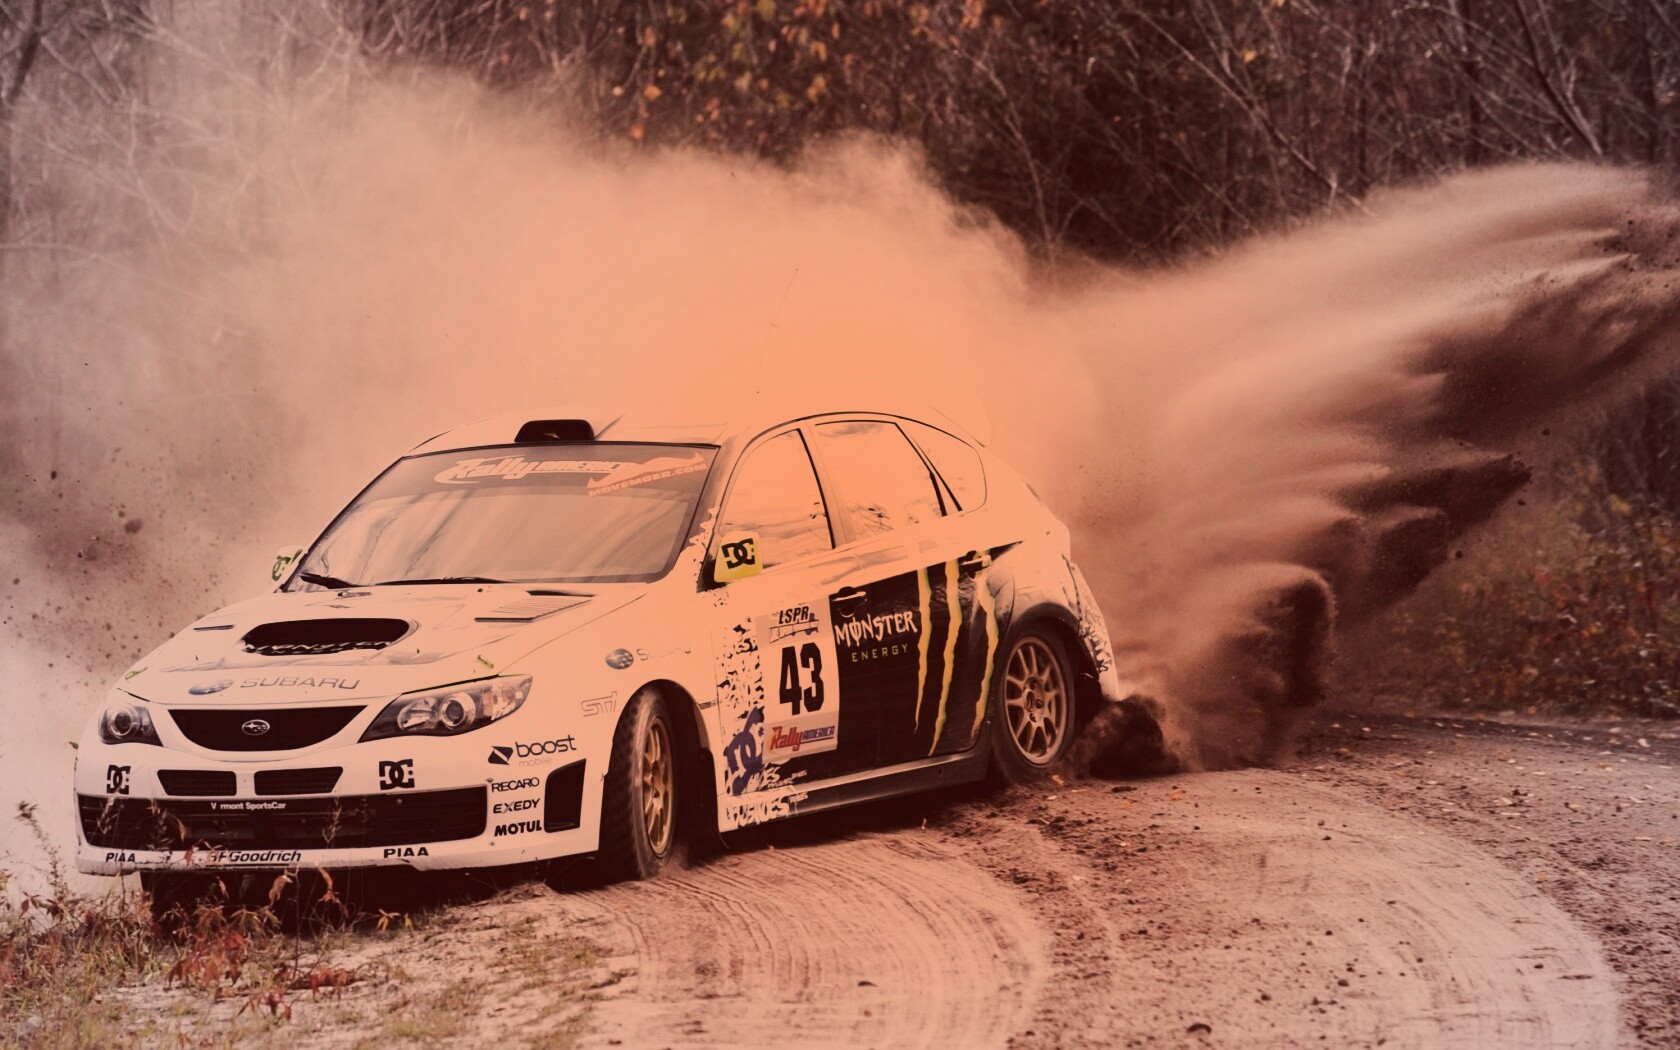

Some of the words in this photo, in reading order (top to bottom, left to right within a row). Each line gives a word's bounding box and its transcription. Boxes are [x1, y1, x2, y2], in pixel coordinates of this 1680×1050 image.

[721, 538, 756, 569] DC
[779, 605, 810, 624] LSPR
[834, 611, 918, 647] MONSTER
[851, 644, 909, 663] ENERGY
[240, 677, 361, 690] SUBARU
[779, 642, 824, 716] 43
[515, 735, 577, 757] boost
[106, 765, 131, 795] DC
[378, 759, 415, 790] DC
[491, 777, 540, 793] RECARO
[210, 802, 244, 810] Vrmont
[245, 801, 287, 811] SportsCar
[493, 798, 541, 814] EXEDY
[494, 820, 542, 837] MOTUL
[106, 852, 136, 863] PIAA
[384, 847, 429, 859] PIAA
